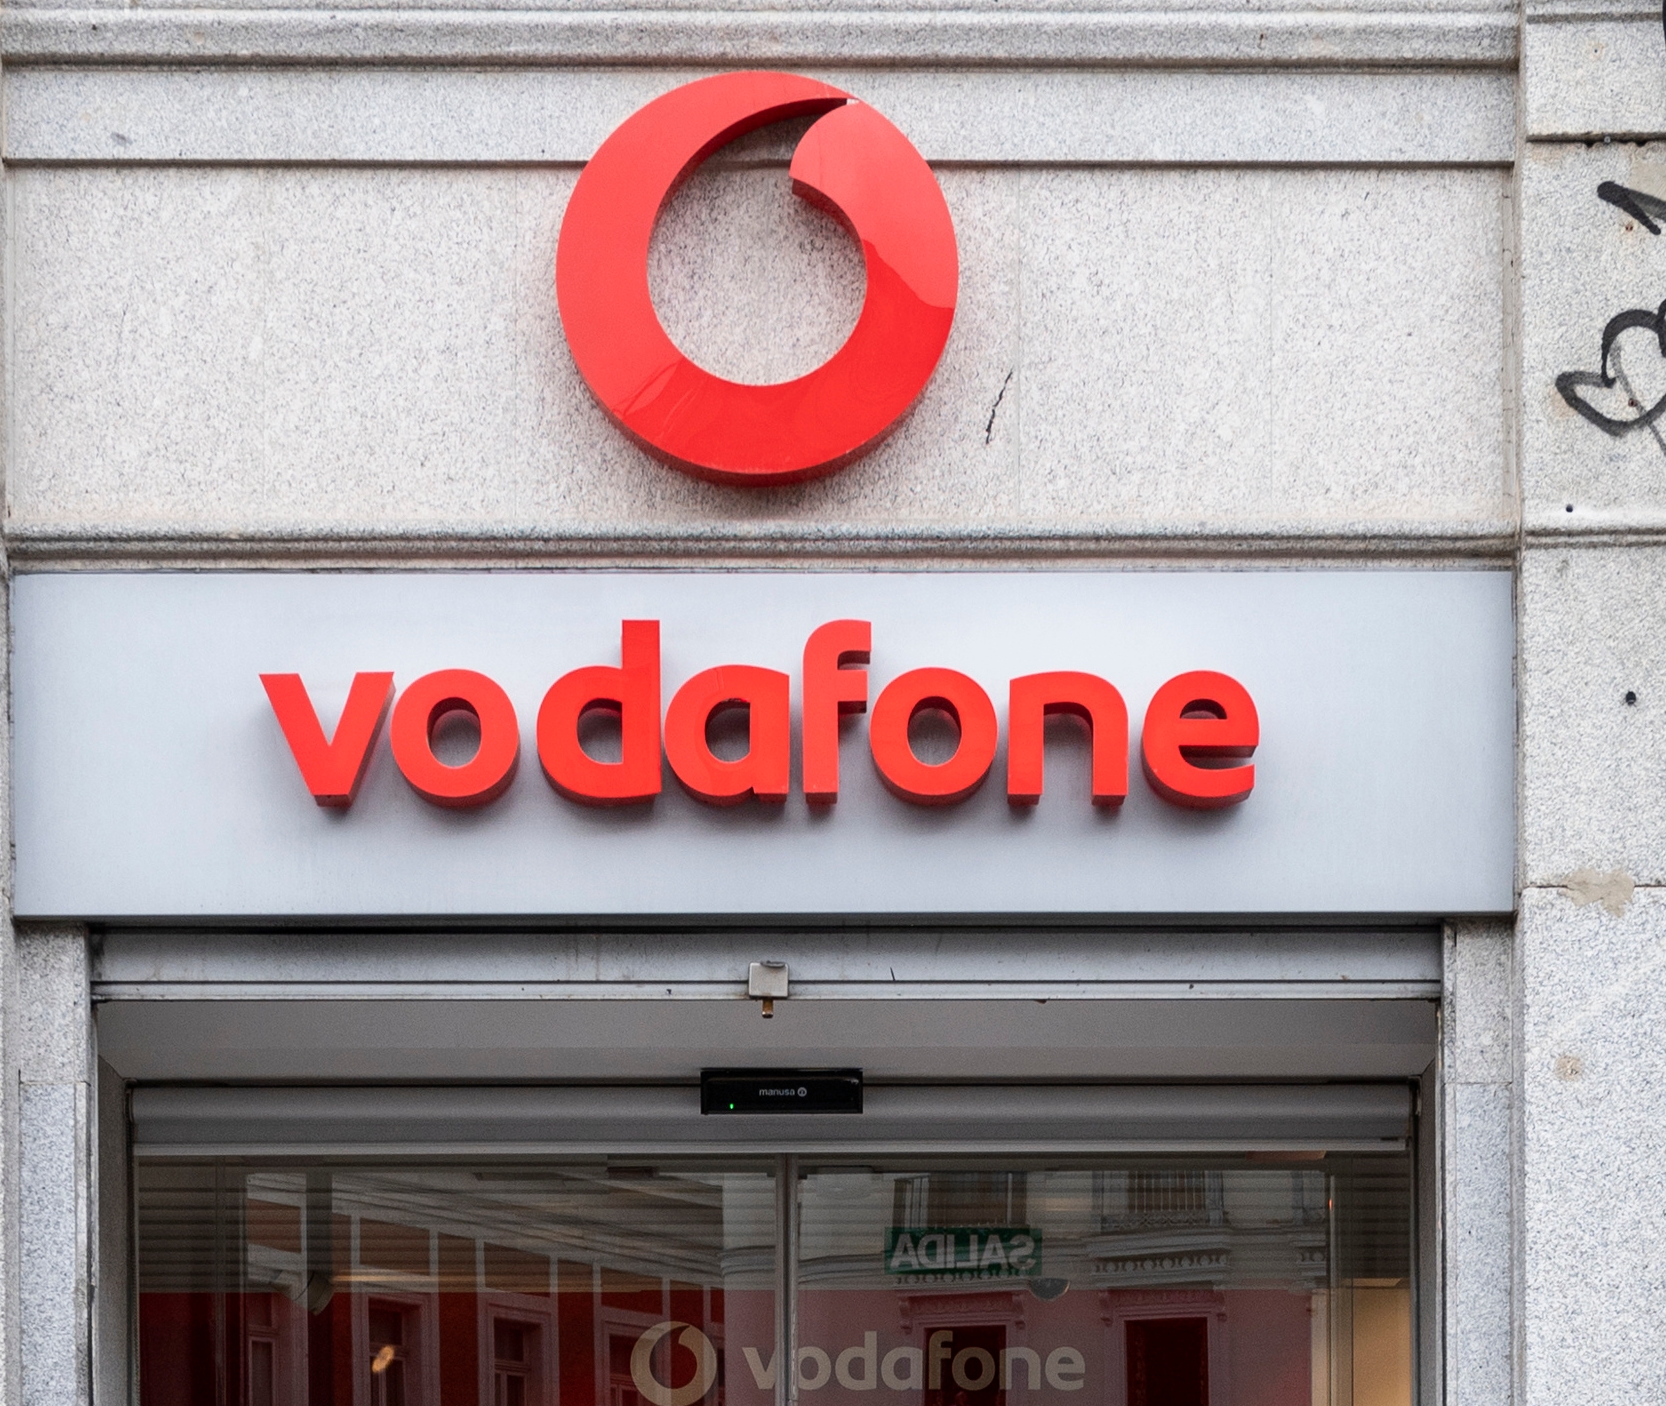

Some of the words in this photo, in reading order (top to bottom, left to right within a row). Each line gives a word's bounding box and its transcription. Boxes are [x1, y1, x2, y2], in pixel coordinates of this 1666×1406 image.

[259, 619, 1259, 806] vodafone
[759, 1088, 795, 1096] manusa
[742, 1330, 1086, 1391] vodafone
